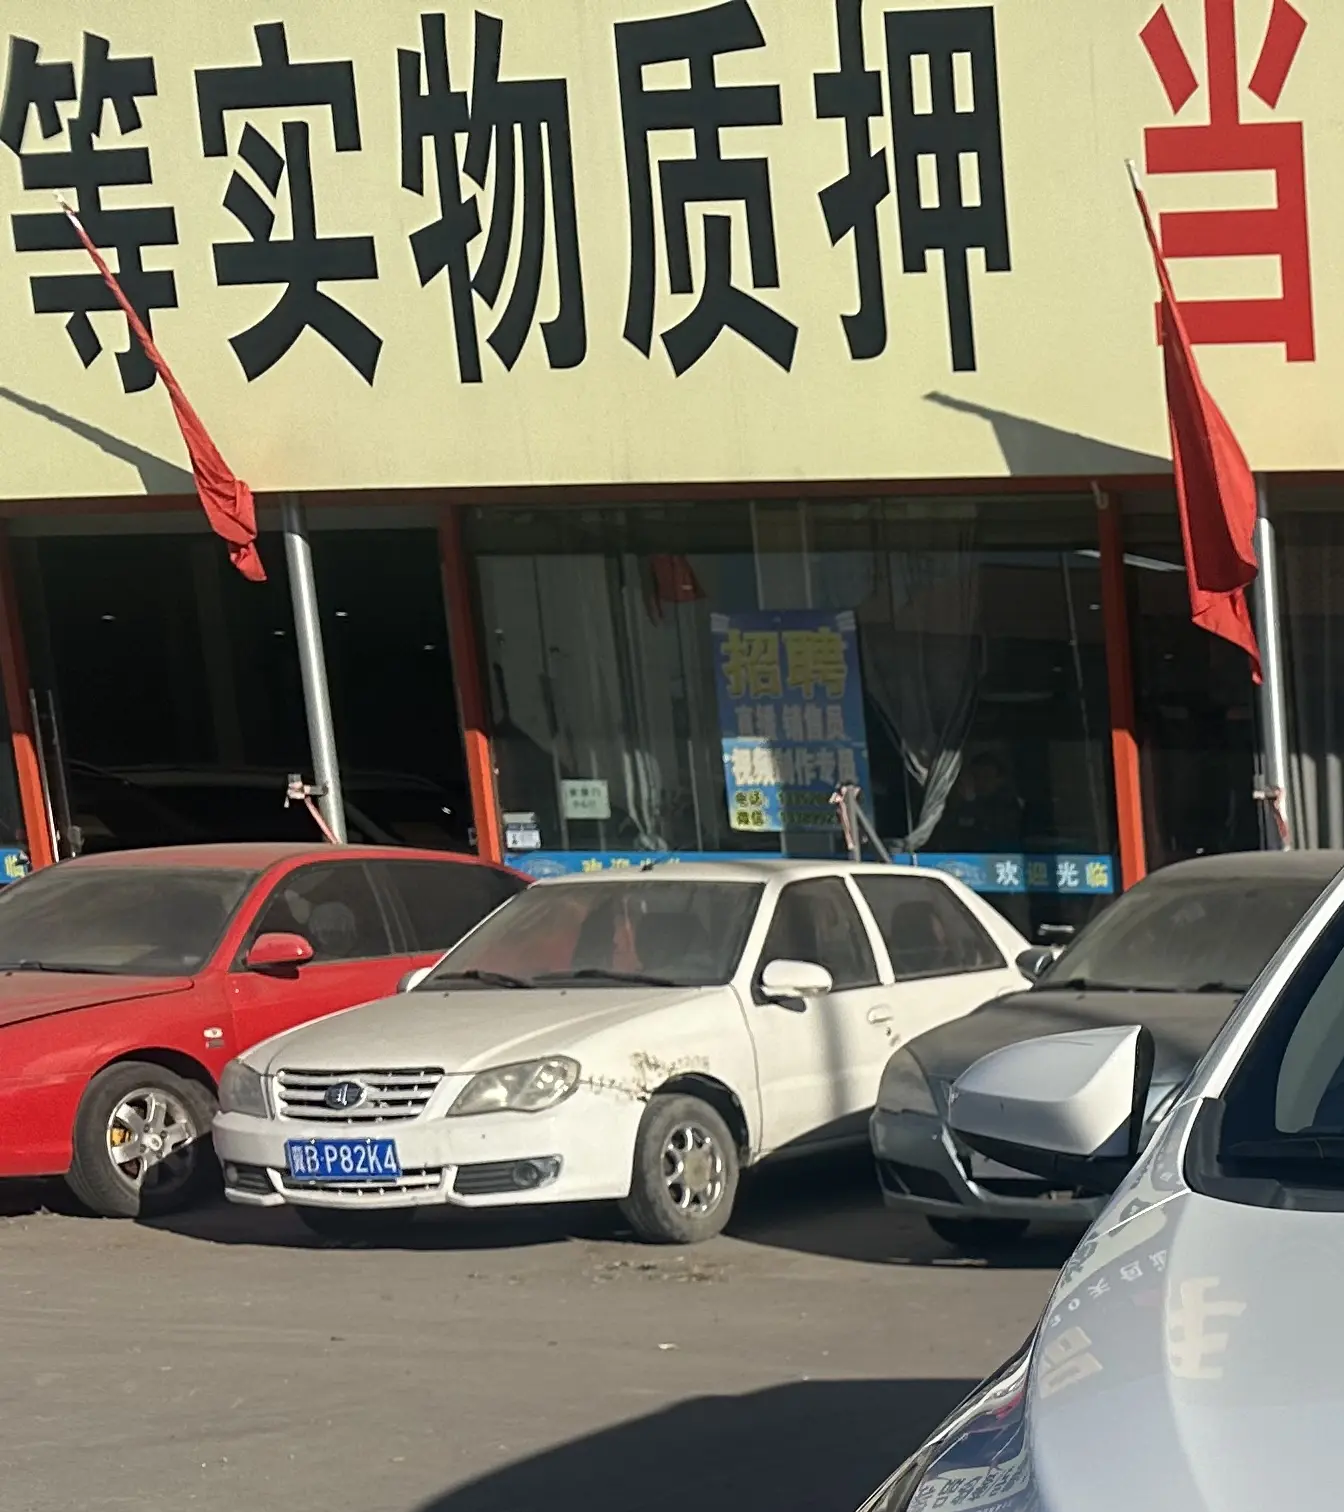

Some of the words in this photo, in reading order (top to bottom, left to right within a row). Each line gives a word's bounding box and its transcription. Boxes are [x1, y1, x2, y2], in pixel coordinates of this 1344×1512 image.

[0, 0, 1010, 393] 等实物质押
[720, 627, 847, 698] 招聘
[994, 860, 1109, 888] 欢迎光临
